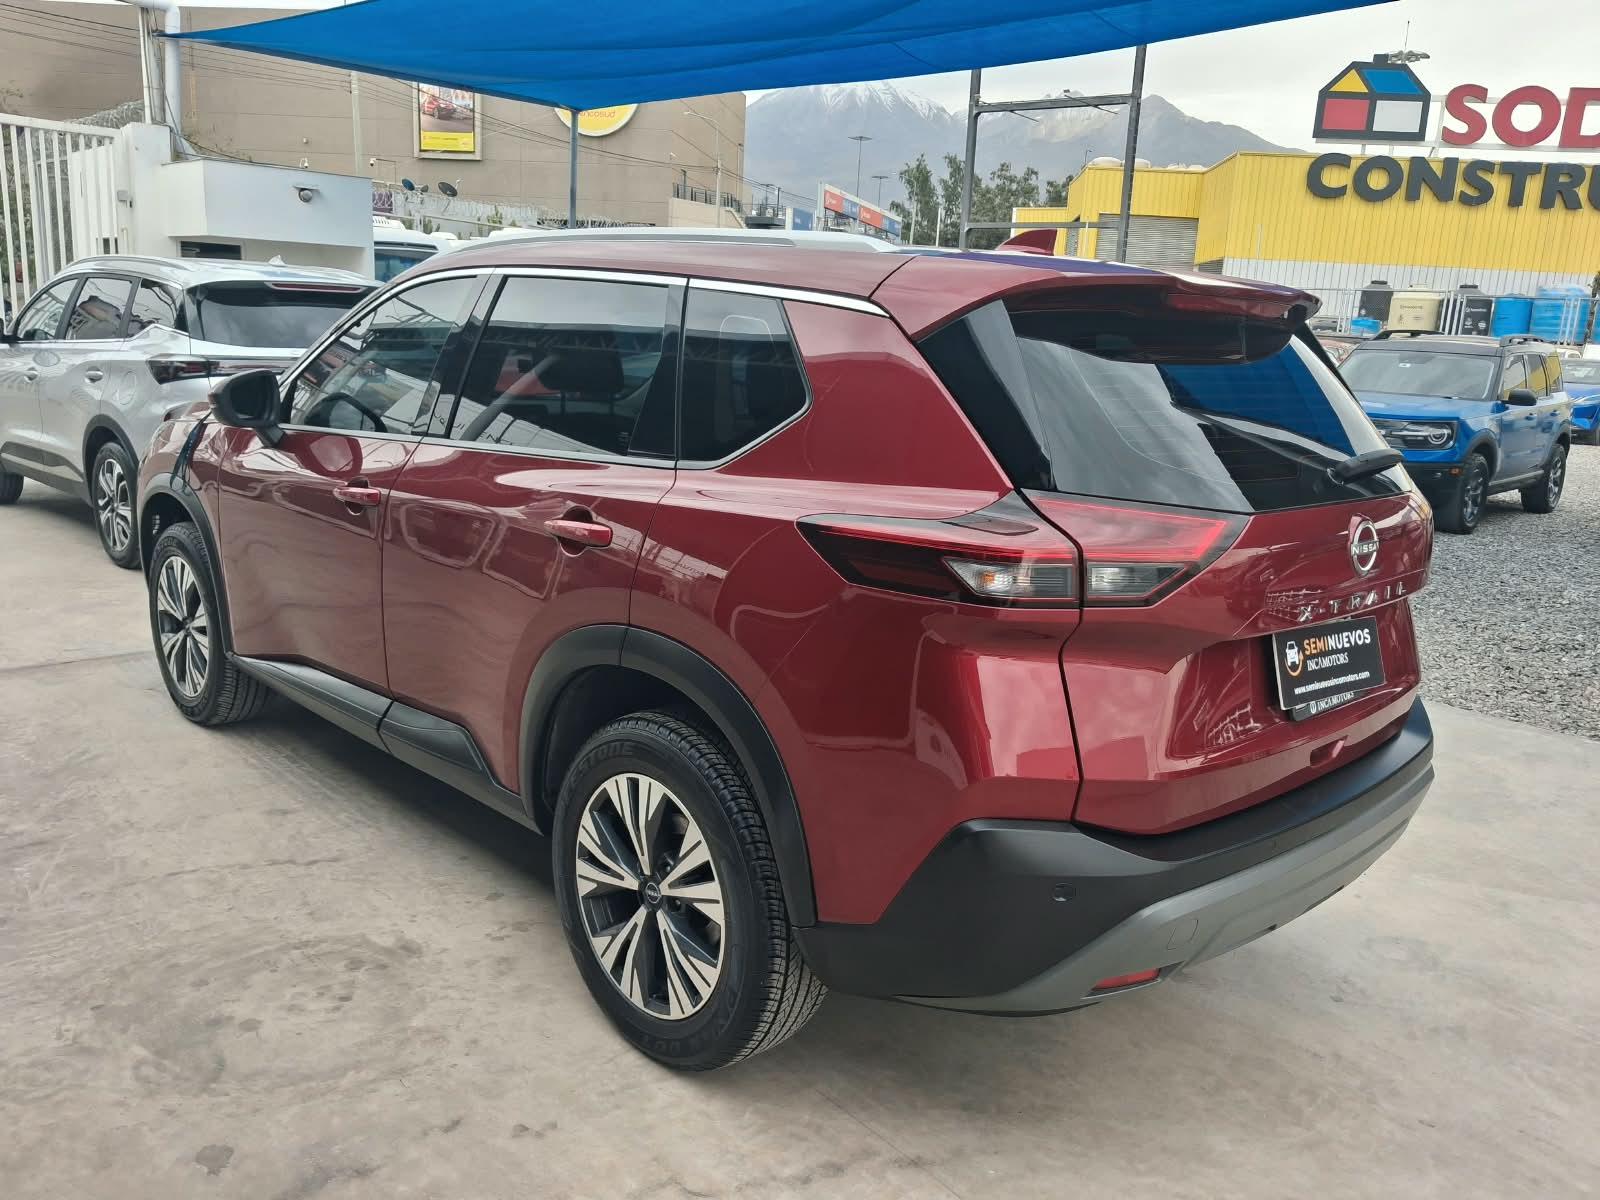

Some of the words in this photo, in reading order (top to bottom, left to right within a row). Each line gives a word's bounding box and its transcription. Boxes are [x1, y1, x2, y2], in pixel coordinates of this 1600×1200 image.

[1442, 84, 1600, 148] SOD
[1304, 628, 1371, 655] SEMINUEVOS
[1307, 652, 1349, 671] INCAMOTORS
